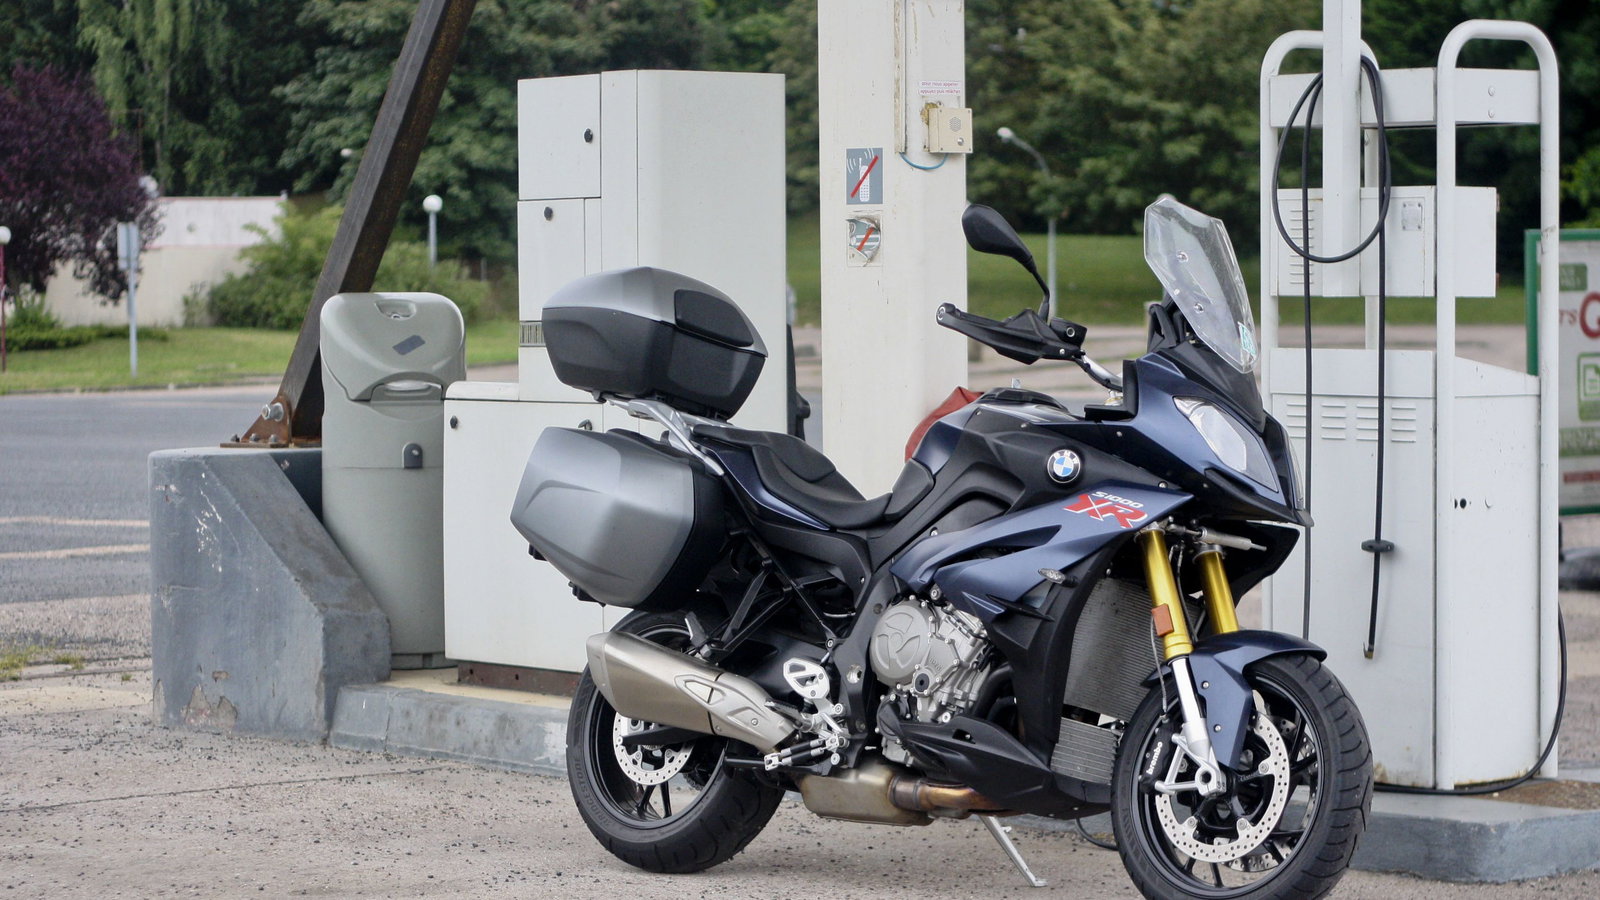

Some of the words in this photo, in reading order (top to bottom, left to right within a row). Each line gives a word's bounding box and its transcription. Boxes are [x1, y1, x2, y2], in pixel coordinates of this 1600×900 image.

[1053, 450, 1080, 464] BMW
[1063, 493, 1148, 528] XR
[1091, 491, 1144, 508] S1000
[1146, 741, 1163, 775] brembo
